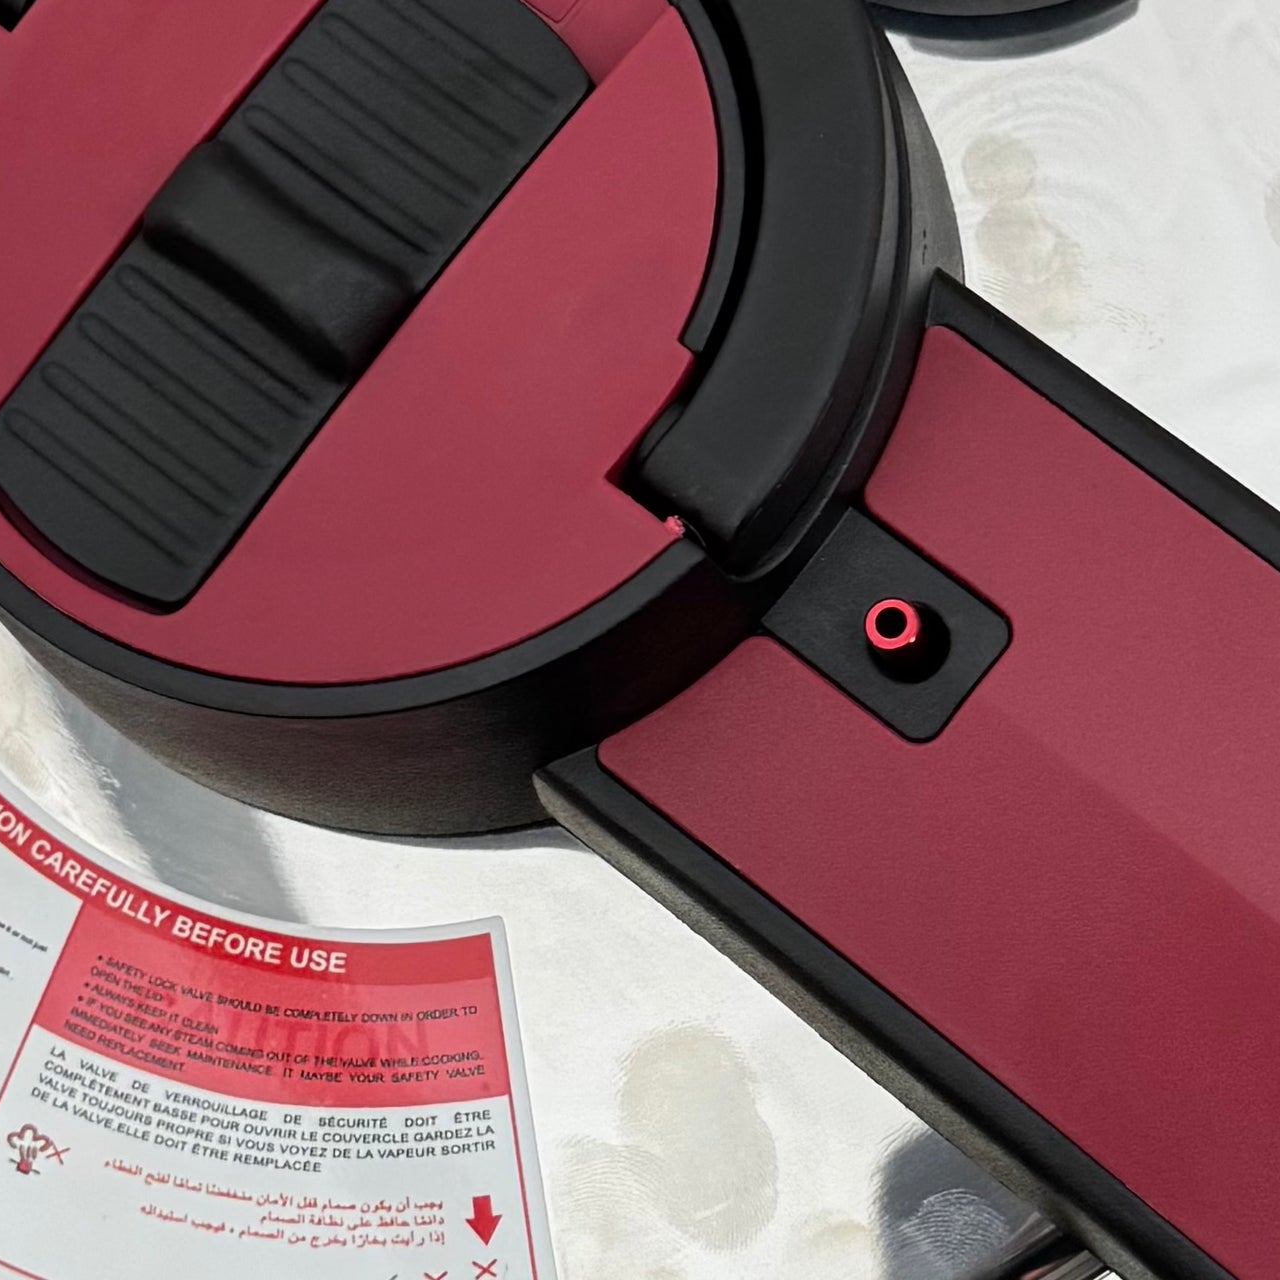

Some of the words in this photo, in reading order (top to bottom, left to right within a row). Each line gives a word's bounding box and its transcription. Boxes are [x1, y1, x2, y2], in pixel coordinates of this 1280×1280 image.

[29, 838, 173, 929] CAREFULLY
[172, 914, 283, 965] BEFORE
[289, 946, 349, 974] USE
[89, 965, 119, 987] OPEN
[122, 978, 146, 997] THE
[144, 988, 164, 1003] LID
[91, 983, 136, 1010] ALWAYS
[136, 999, 168, 1018] KEEP
[169, 1013, 180, 1023] IT
[181, 1017, 220, 1035] CLEAN
[106, 955, 147, 981] SAFETY
[147, 975, 178, 993] LOCK
[180, 985, 213, 1003] VALVE
[216, 992, 262, 1014] SHOULD
[265, 1003, 280, 1017] BE
[283, 1006, 358, 1023] COMPLETELY
[360, 1012, 398, 1024] DOWN
[401, 1011, 414, 1022] IN
[416, 1007, 459, 1021] ORDER
[461, 1005, 478, 1016] TO
[63, 1019, 97, 1041] NEED
[97, 1034, 186, 1072] REPLACEMENT
[70, 1006, 147, 1043] IMMEDIATELY
[148, 1038, 182, 1056] SEEK
[186, 1049, 275, 1077] MAINTENANCE
[282, 1066, 294, 1078] IT
[300, 1070, 344, 1084] MAYBE
[349, 1072, 386, 1085] YOUR
[390, 1069, 440, 1083] SAFETY
[446, 1064, 486, 1079] VALVE
[86, 996, 98, 1008] IF
[99, 1002, 123, 1020] YOU
[124, 1011, 147, 1029] SEE
[147, 1021, 173, 1037] ANY
[173, 1028, 216, 1051] STEAM
[266, 1048, 292, 1063] OUT
[294, 1052, 311, 1065] OF
[313, 1056, 339, 1068] THE
[340, 1056, 377, 1069] VALVE
[30, 1086, 50, 1102] DE
[52, 1095, 70, 1111] LA
[153, 1135, 189, 1153] DOIT
[37, 1072, 77, 1100] VALVE
[81, 1092, 154, 1127] TOUJOURS
[155, 1118, 214, 1145] PROPRE
[218, 1131, 232, 1145] SI
[235, 1136, 276, 1154] VOUS
[279, 1143, 328, 1158] VOYEZ
[332, 1147, 352, 1159] DE
[356, 1148, 375, 1160] LA
[377, 1145, 437, 1159] VAPEUR
[440, 1139, 497, 1156] SORTIR
[50, 1045, 67, 1062] LA
[79, 1058, 118, 1083] VALVE
[131, 1079, 151, 1094] DE
[283, 1113, 303, 1125] DE
[318, 1114, 388, 1129] SÉCURITÉ
[404, 1115, 439, 1128] DOIT
[153, 1102, 197, 1123] BASSE
[200, 1114, 241, 1133] POUR
[243, 1123, 298, 1140] OUVRIR
[300, 1130, 319, 1142] LE
[322, 1131, 410, 1145] COUVERCLE
[413, 1124, 474, 1143] GARDEZ
[476, 1126, 496, 1137] LA
